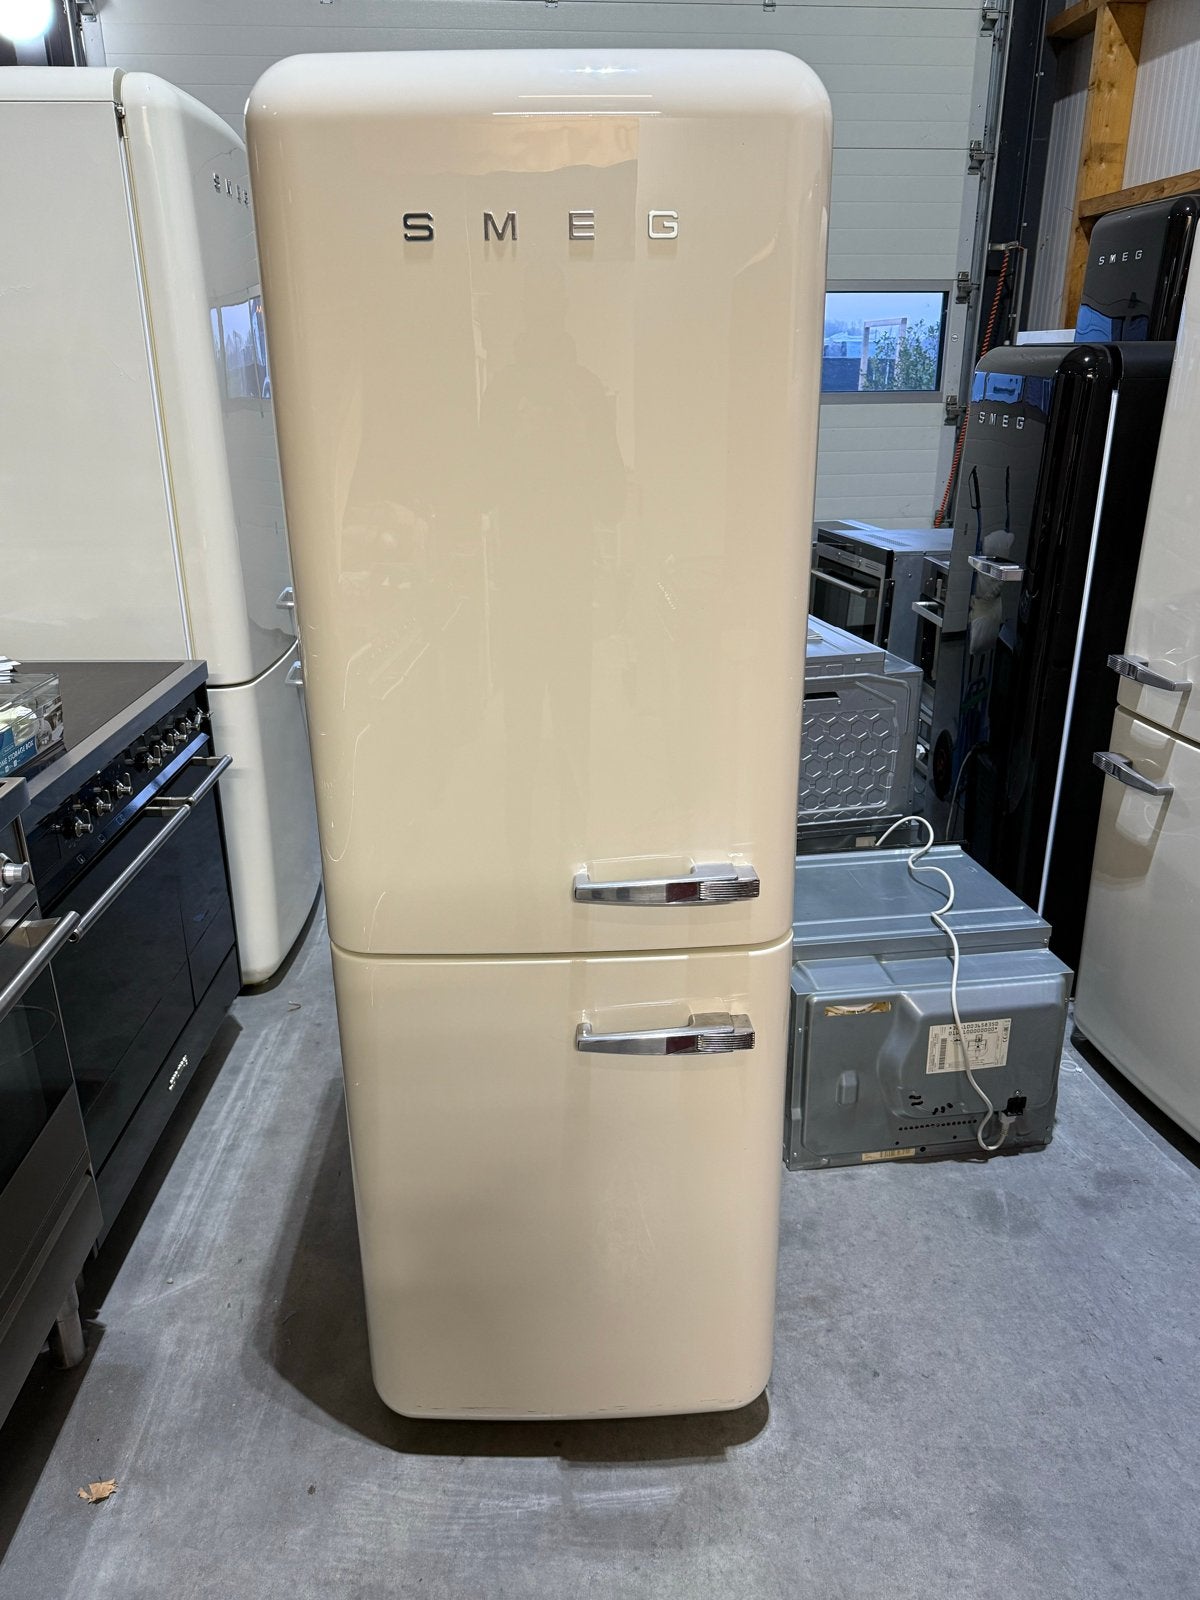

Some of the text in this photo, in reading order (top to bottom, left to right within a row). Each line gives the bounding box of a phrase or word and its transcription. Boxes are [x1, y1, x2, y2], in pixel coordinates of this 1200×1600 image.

[403, 210, 679, 241] SMEG
[1098, 250, 1143, 266] SMEG
[978, 411, 1025, 430] SMEG
